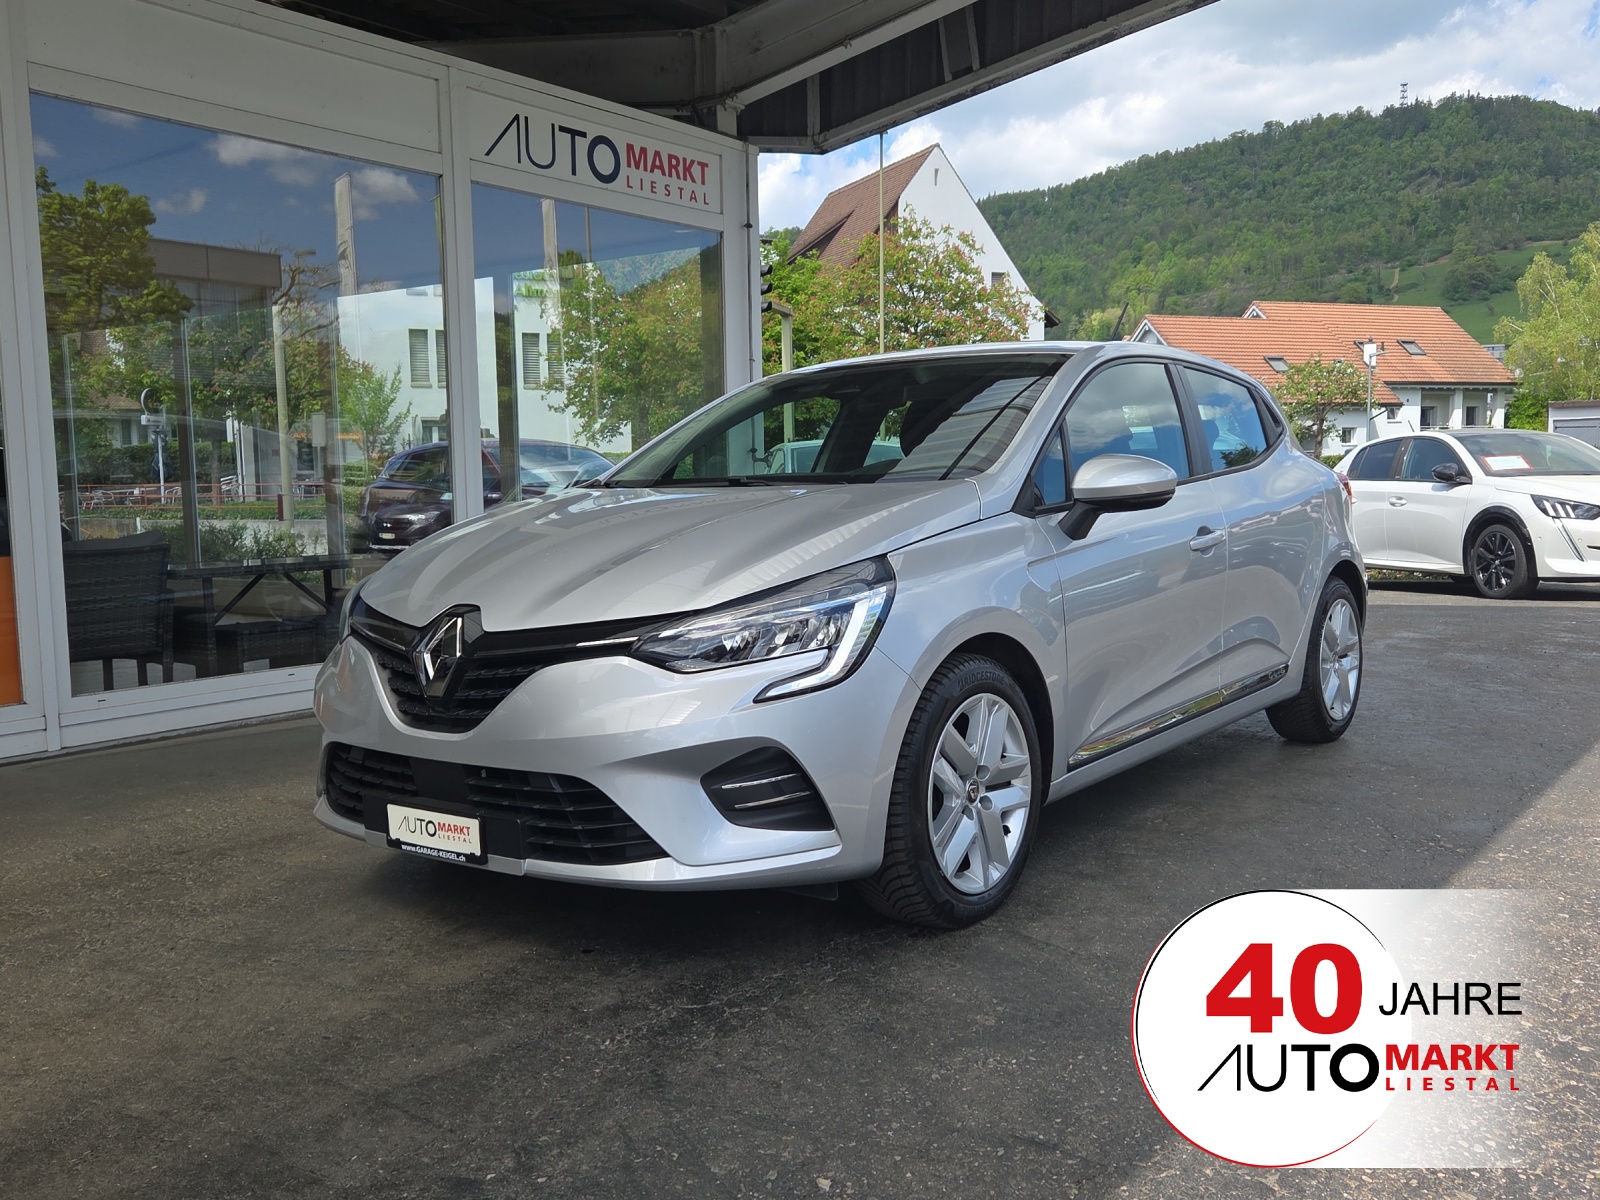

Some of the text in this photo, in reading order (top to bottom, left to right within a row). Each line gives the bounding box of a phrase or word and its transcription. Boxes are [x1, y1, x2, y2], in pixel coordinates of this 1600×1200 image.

[484, 113, 709, 186] AUTO MARKT
[626, 175, 710, 206] LIESTAL
[398, 815, 471, 837] AUTO MARKT
[438, 833, 472, 844] LIESTAL
